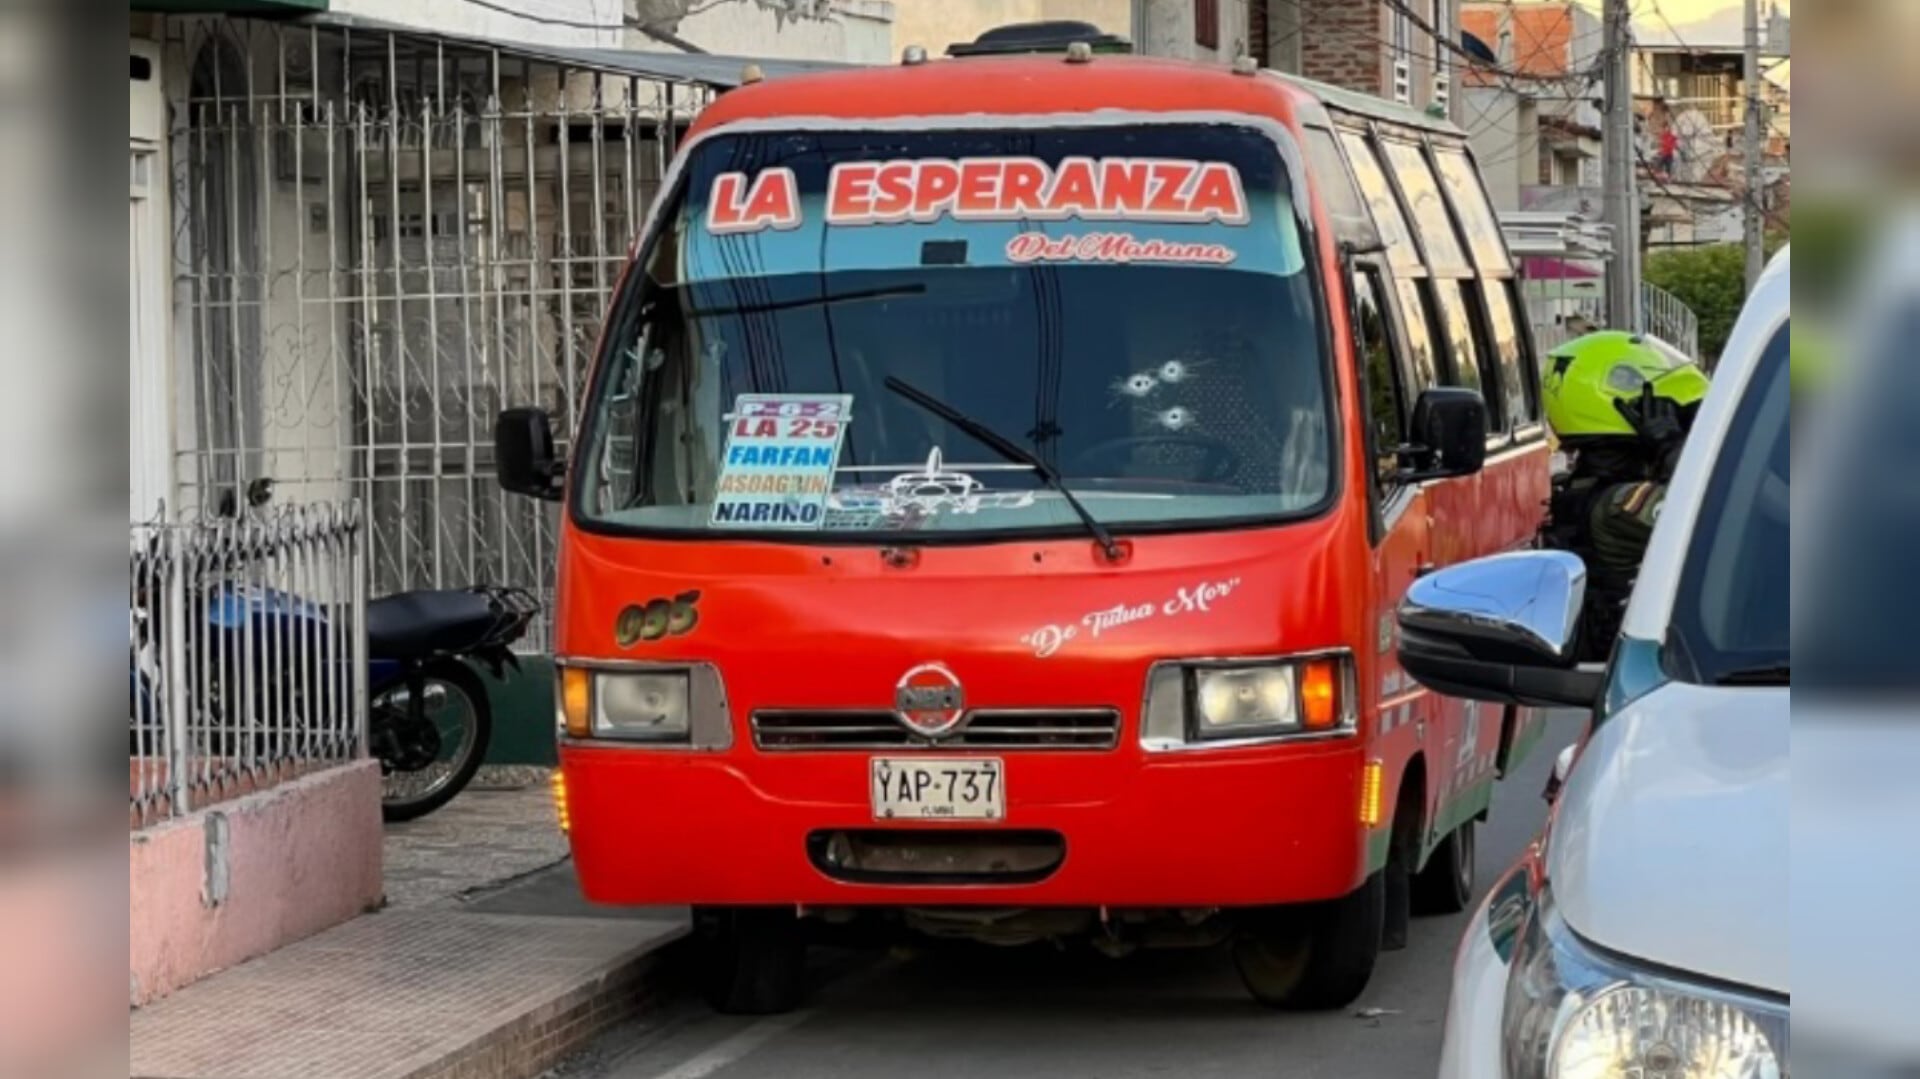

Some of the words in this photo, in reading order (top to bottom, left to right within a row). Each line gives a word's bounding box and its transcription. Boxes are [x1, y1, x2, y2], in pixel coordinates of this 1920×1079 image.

[709, 169, 796, 230] LA
[828, 158, 1246, 223] ESPERANZA
[1007, 233, 1071, 261] Del
[735, 419, 777, 437] LA
[786, 419, 837, 438] 25
[728, 446, 831, 466] FARFAN
